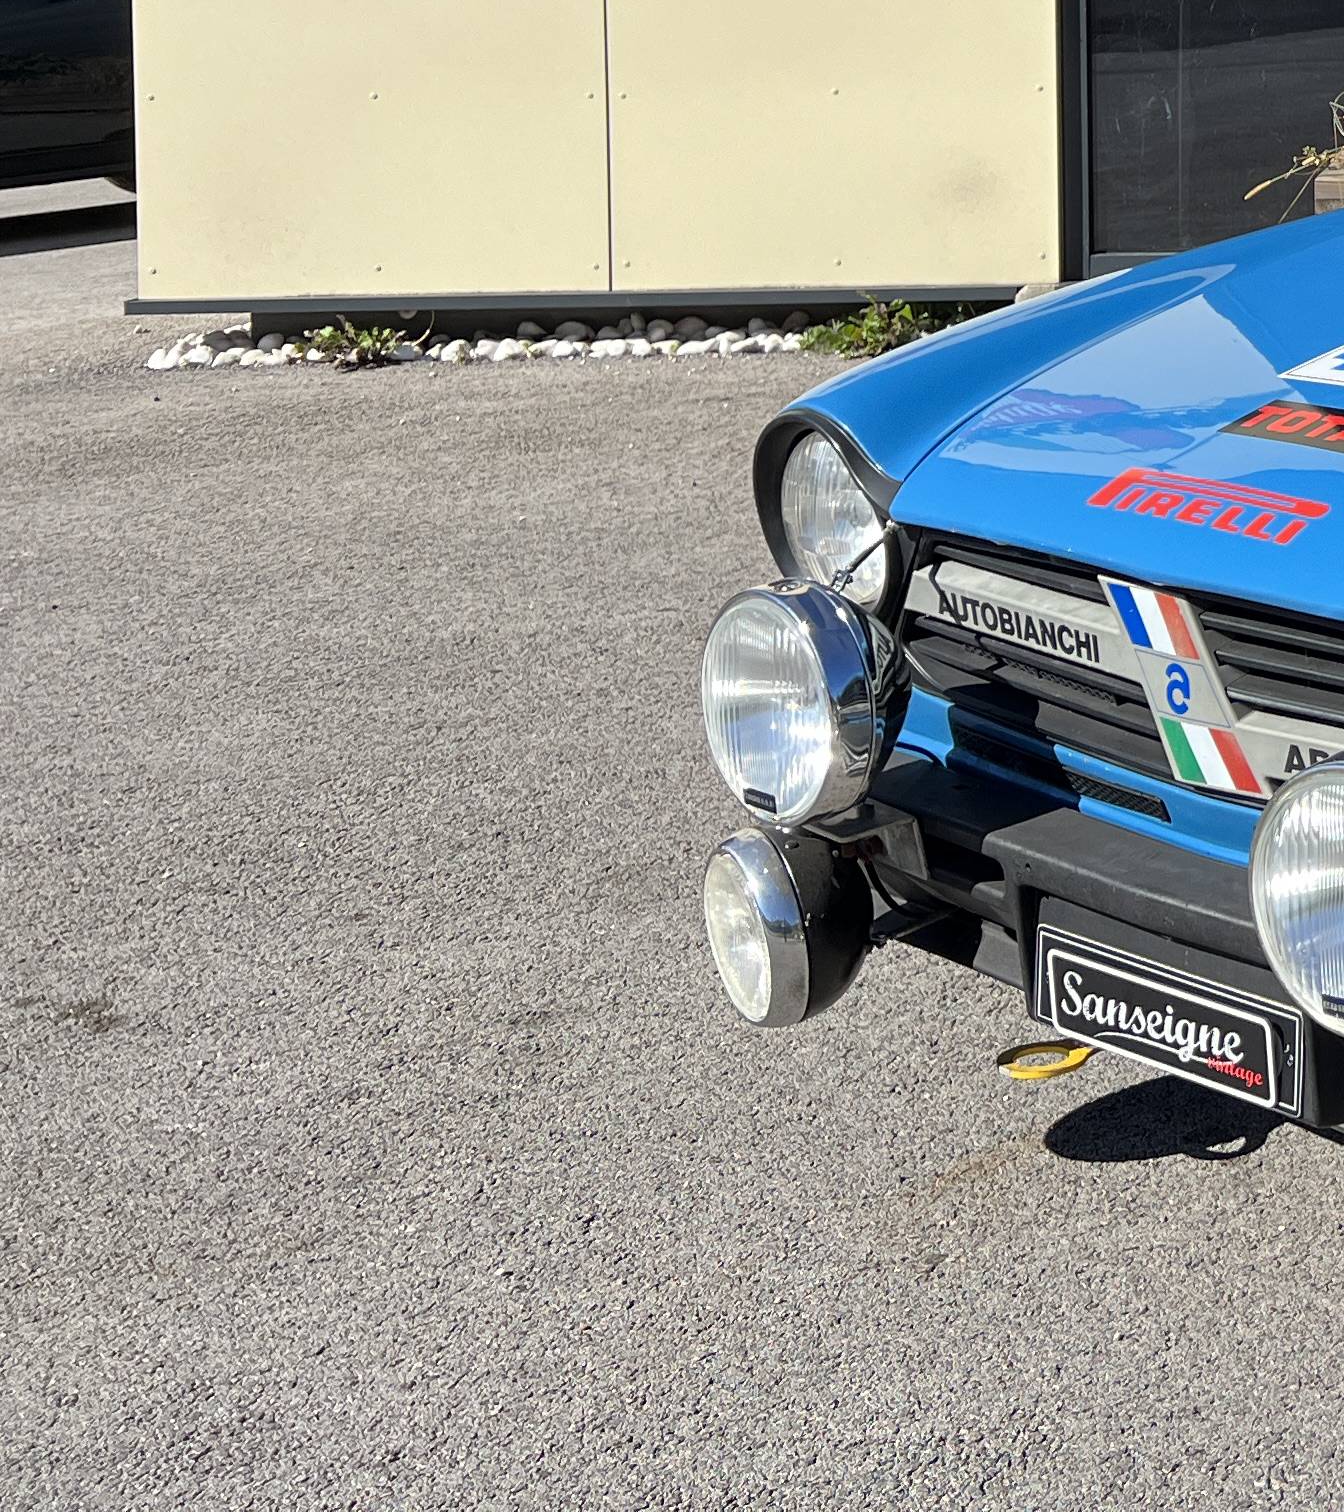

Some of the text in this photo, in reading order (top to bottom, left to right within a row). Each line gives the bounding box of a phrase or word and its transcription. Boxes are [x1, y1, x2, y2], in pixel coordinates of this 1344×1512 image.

[1086, 466, 1332, 546] PIRELLI
[937, 591, 1102, 665] AUTOBIANCHI
[1060, 970, 1245, 1062] Sanseigne
[1206, 1055, 1265, 1088] vintage
